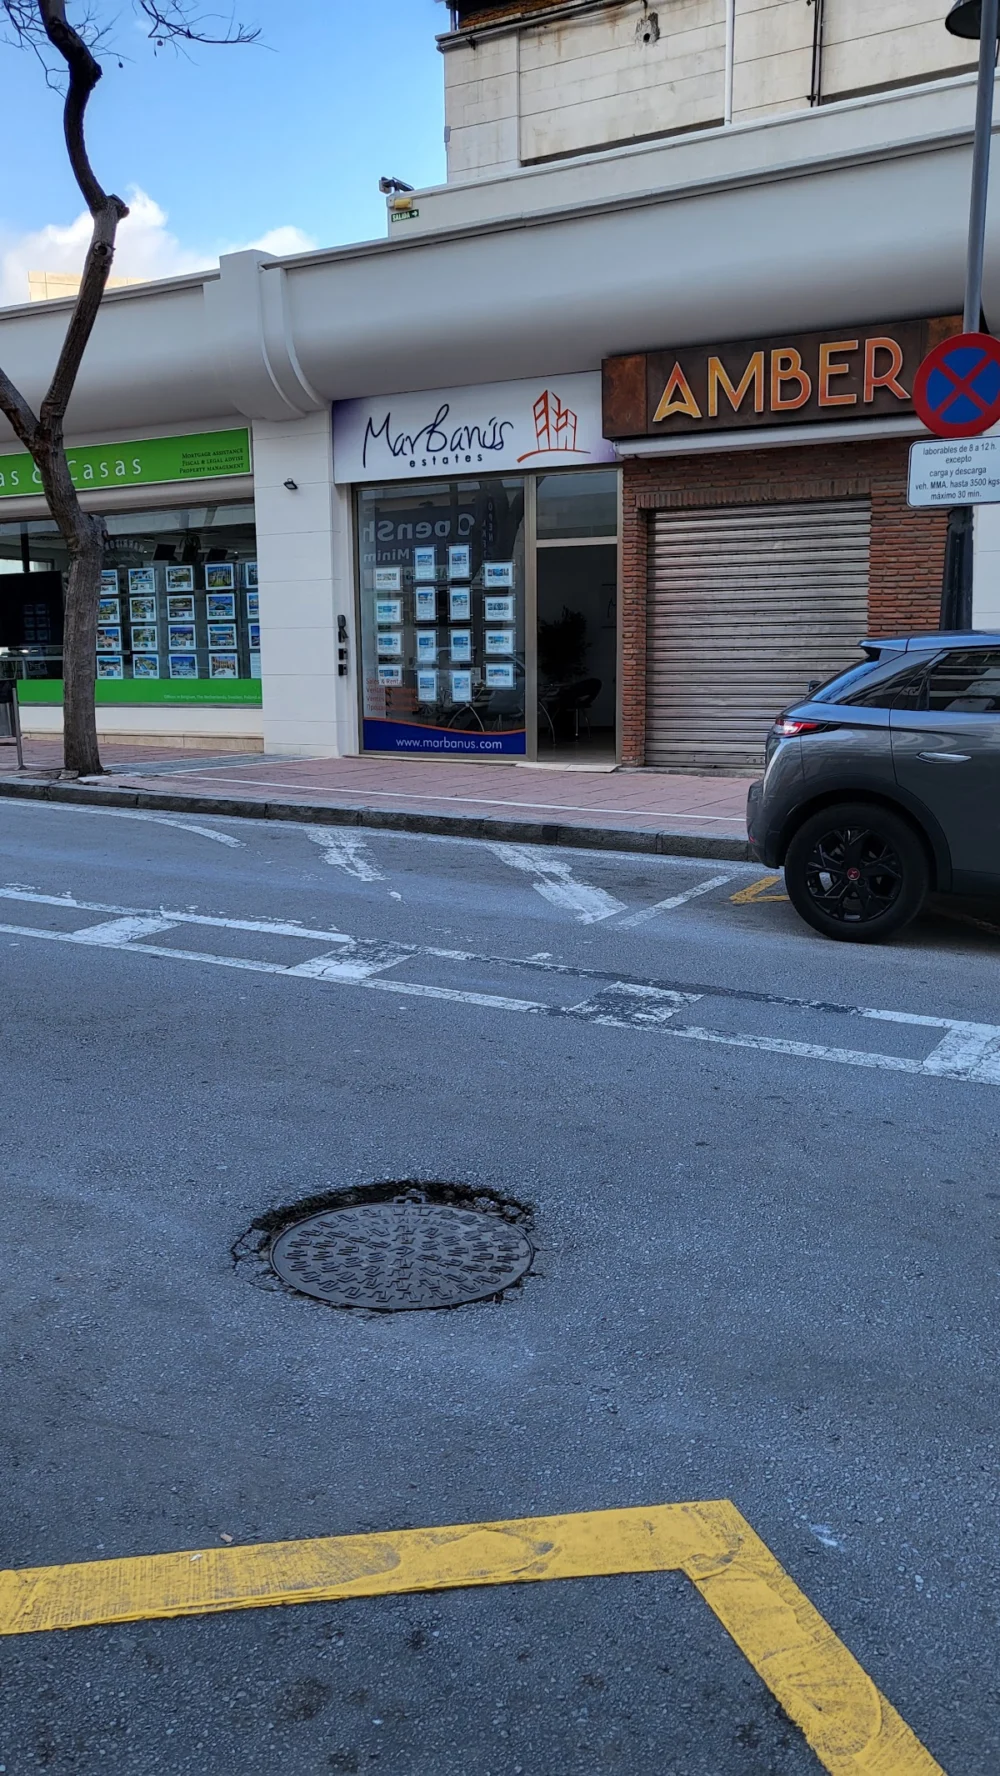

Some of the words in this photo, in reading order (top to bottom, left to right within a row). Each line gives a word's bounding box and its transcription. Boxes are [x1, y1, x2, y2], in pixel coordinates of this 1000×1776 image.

[392, 212, 410, 222] SALIDA
[652, 336, 911, 422] AMBER
[212, 448, 243, 456] ASSISTANCE
[923, 446, 958, 455] laborables
[959, 444, 968, 453] de
[968, 443, 974, 452] 8
[981, 442, 990, 451] 12
[409, 453, 483, 468] estates
[945, 455, 972, 464] excepto
[206, 463, 244, 471] MANAGEMENT
[929, 470, 948, 478] carga
[949, 470, 954, 478] y
[955, 466, 987, 476] descarga
[915, 482, 928, 490] veh.
[930, 480, 948, 489] MMA.
[949, 479, 969, 488] hasta
[969, 478, 987, 487] 3500
[930, 491, 957, 500] máximo
[957, 490, 966, 498] 30
[967, 489, 982, 497] min.
[395, 736, 503, 750] www.marbanus.com
